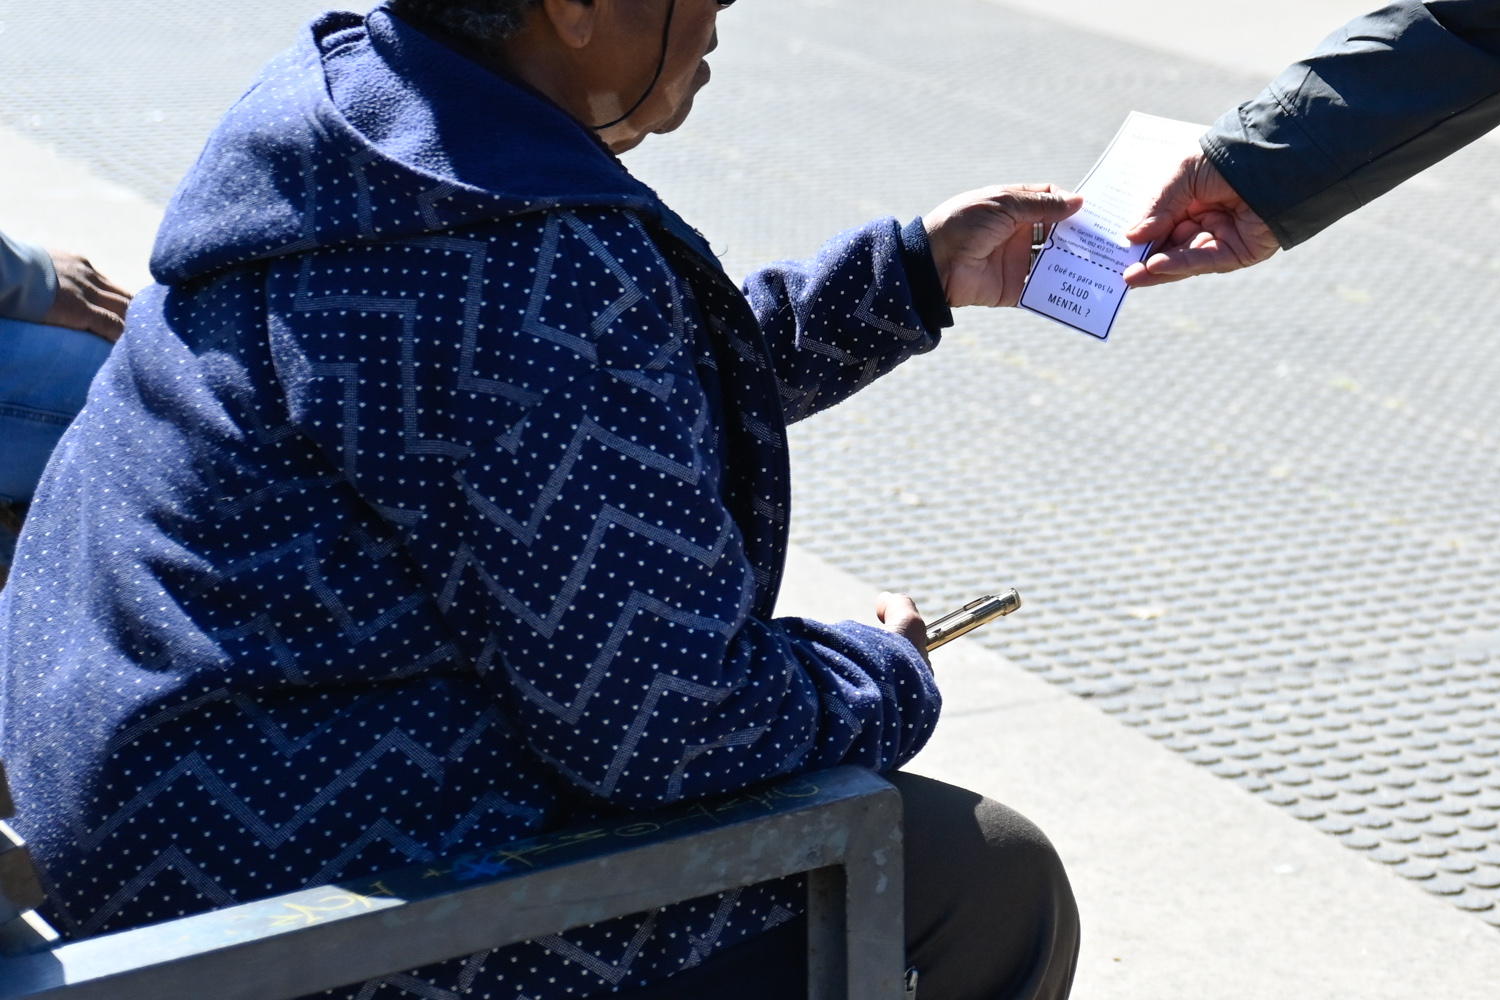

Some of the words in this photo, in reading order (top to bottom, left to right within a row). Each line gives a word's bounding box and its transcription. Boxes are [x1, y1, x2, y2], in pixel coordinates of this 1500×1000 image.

[1093, 222, 1118, 236] Mental
[1096, 243, 1106, 251] 412
[1105, 247, 1114, 255] 571
[1053, 264, 1067, 275] Qué
[1068, 271, 1076, 279] es
[1076, 275, 1092, 286] para
[1094, 282, 1106, 291] vos
[1106, 285, 1114, 294] la
[1060, 281, 1089, 300] SALUD
[1047, 293, 1082, 315] MENTAL
